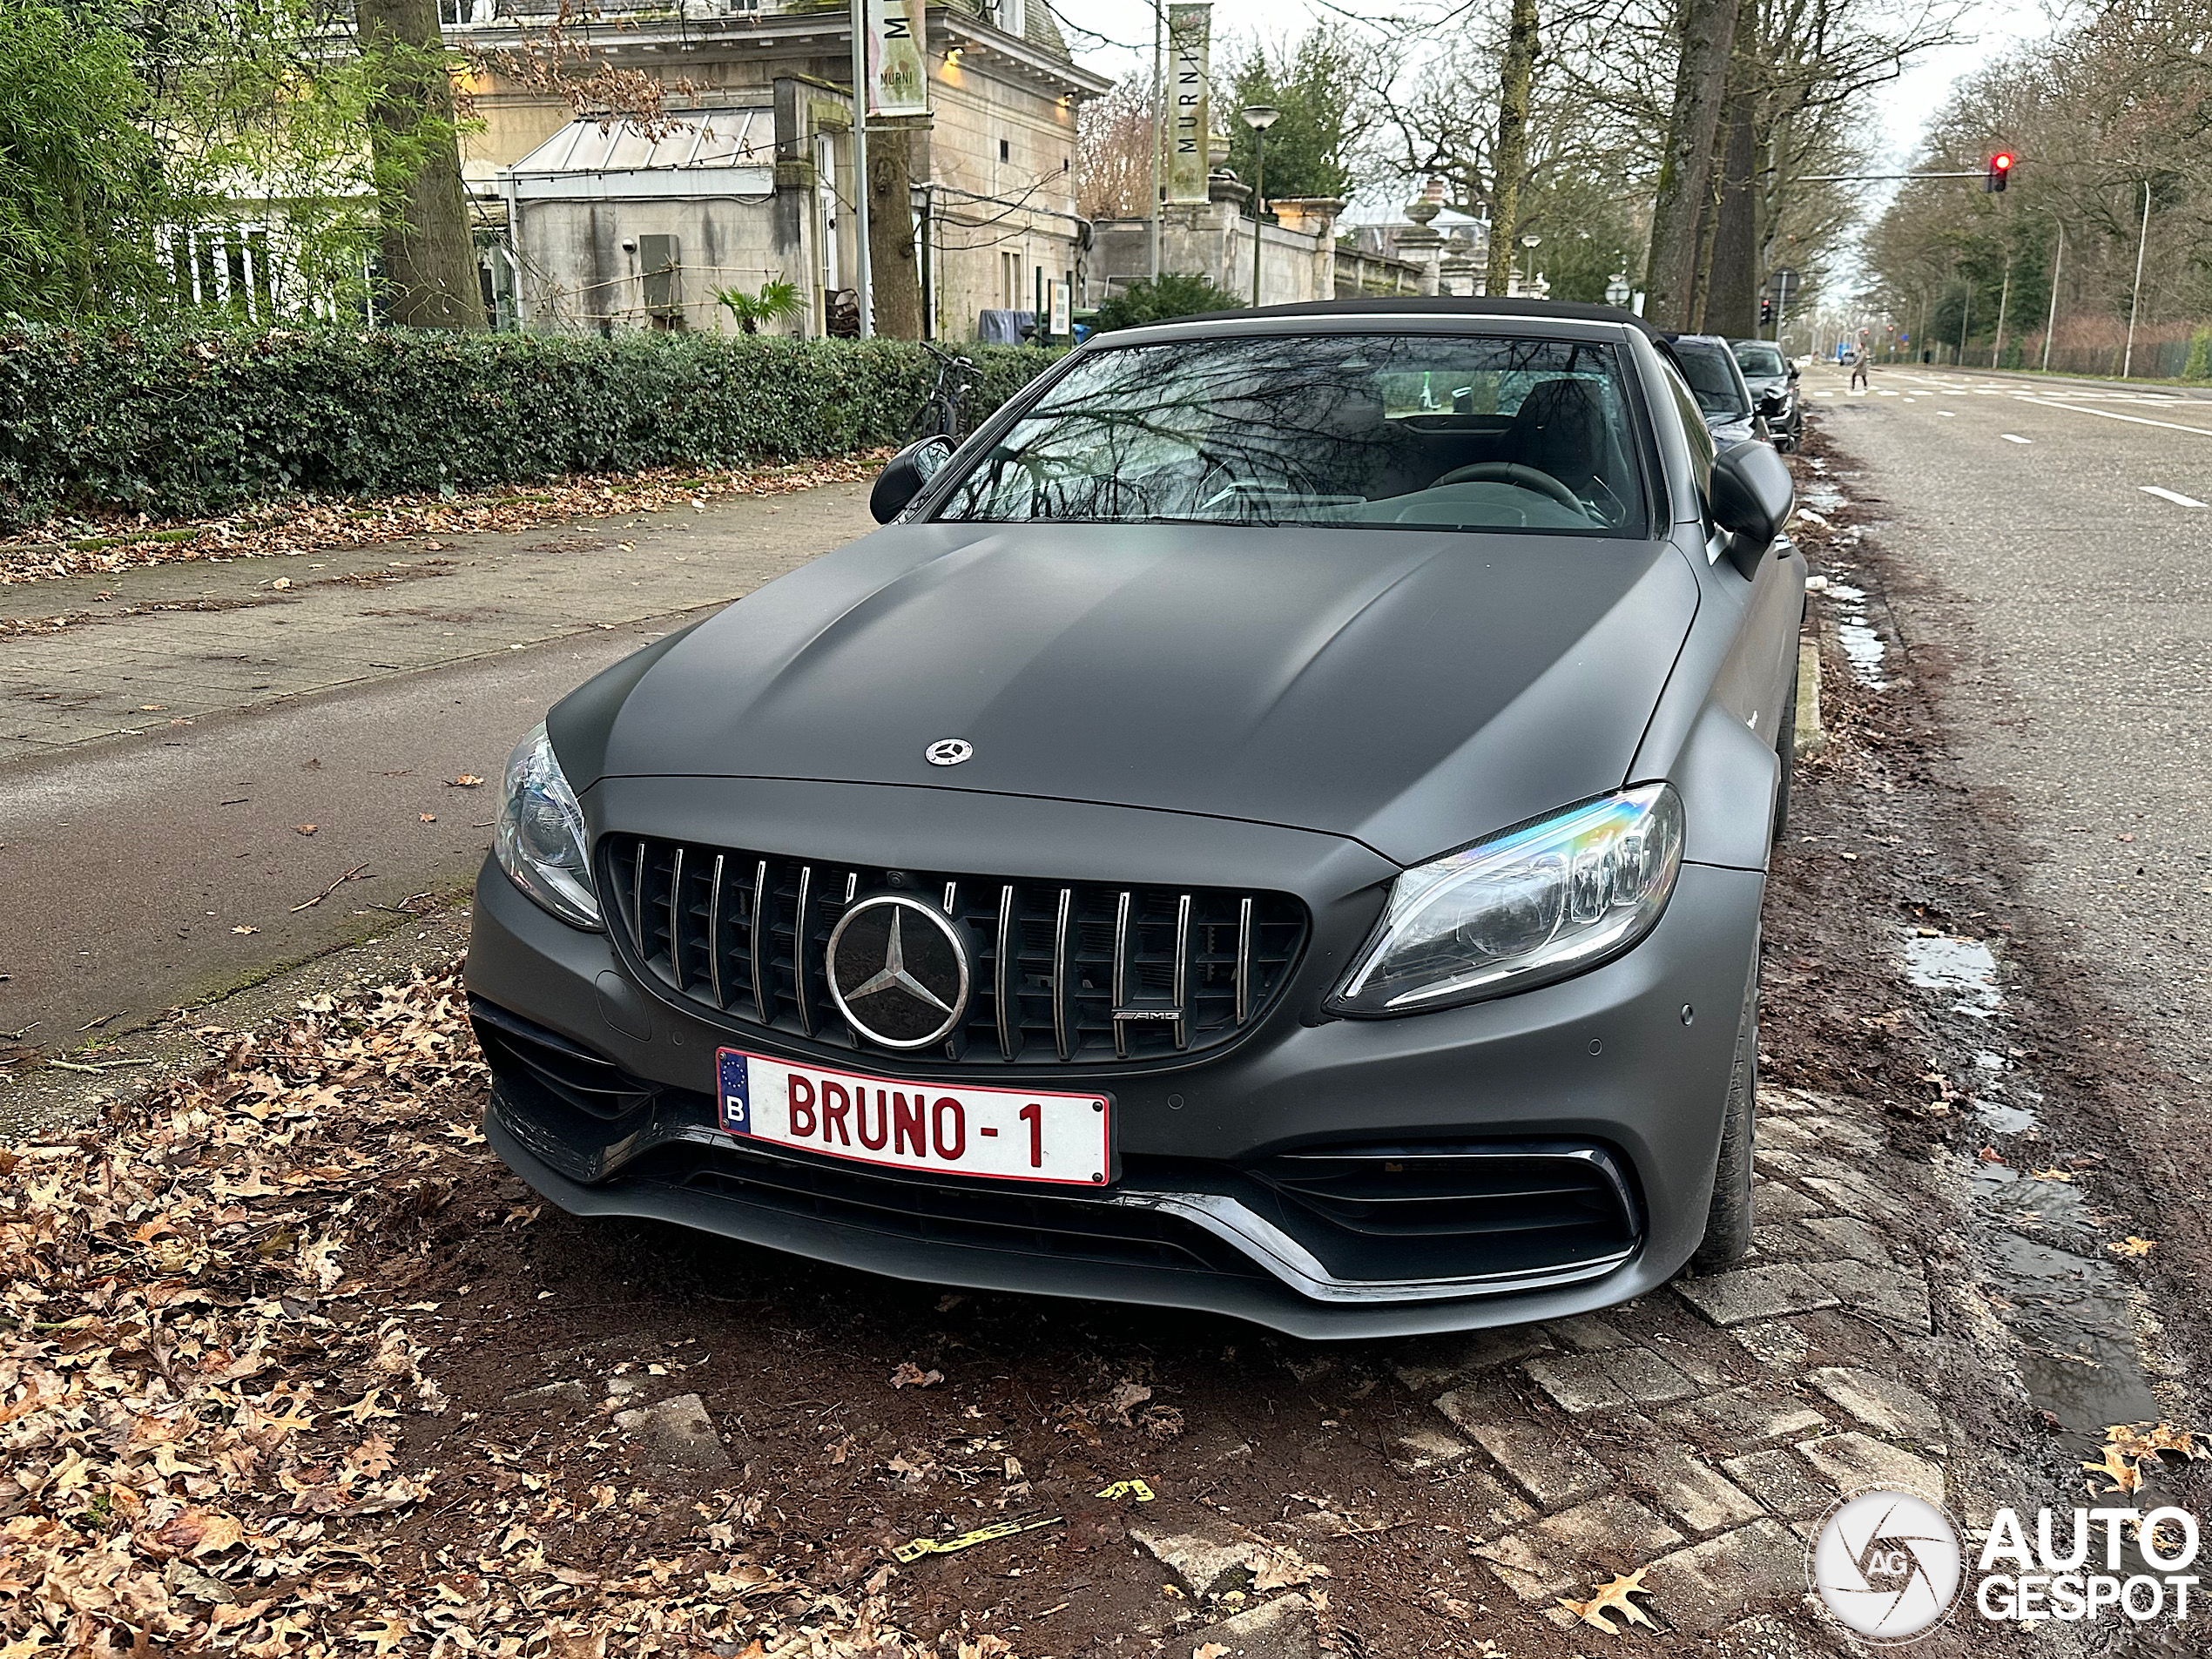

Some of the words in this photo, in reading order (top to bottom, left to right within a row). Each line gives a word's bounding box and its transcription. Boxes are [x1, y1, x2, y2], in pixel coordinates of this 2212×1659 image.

[880, 72, 913, 85] MURNI
[1178, 57, 1199, 152] MURNI
[726, 1096, 745, 1122] B
